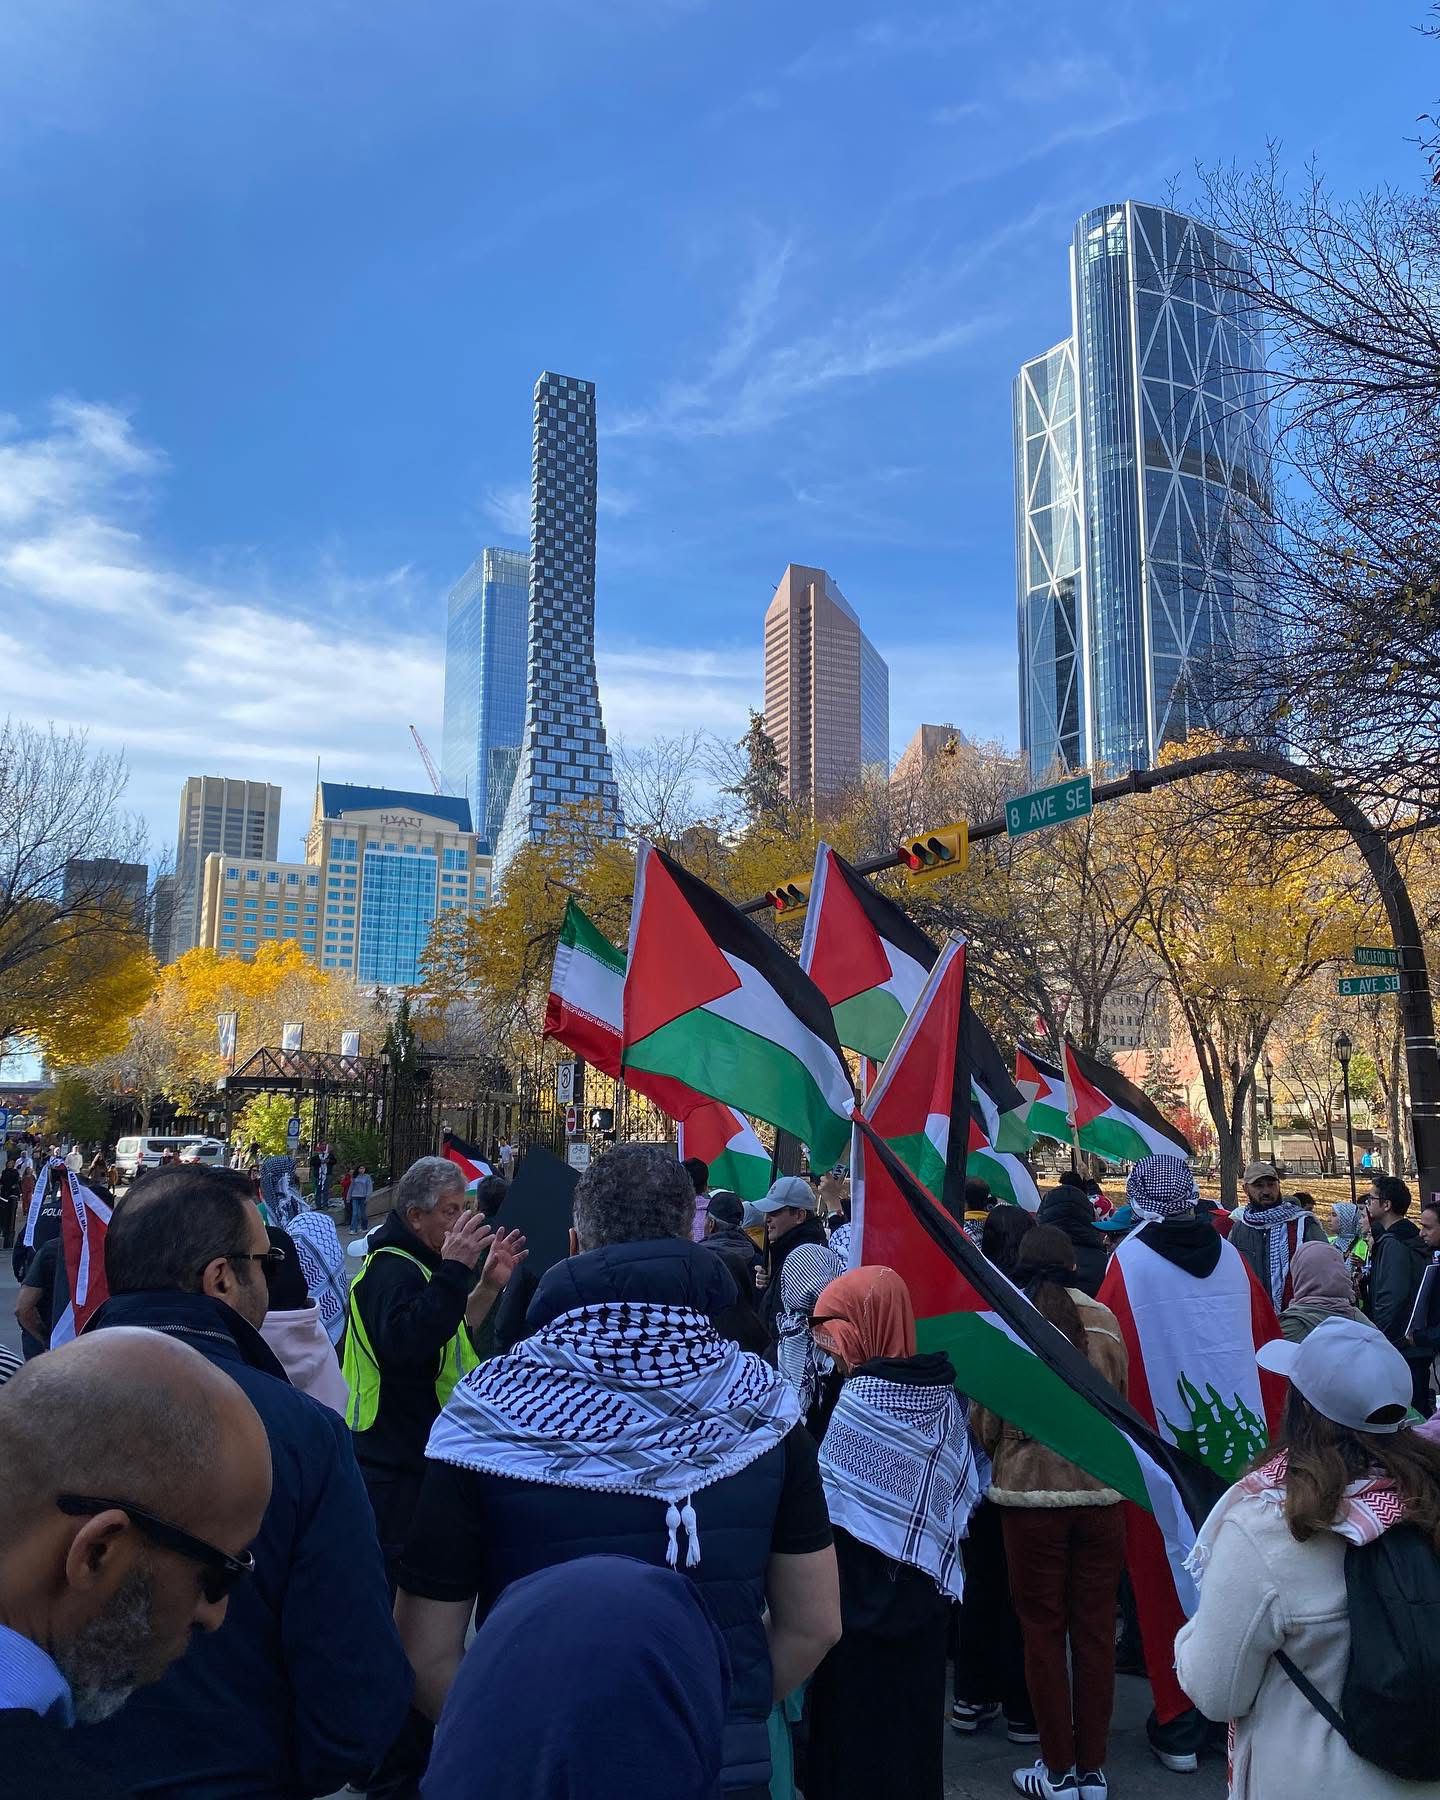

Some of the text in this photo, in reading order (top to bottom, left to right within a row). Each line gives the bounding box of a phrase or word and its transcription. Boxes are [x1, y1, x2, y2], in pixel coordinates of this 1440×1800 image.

[1010, 786, 1086, 828] 8 AVE SE
[380, 814, 424, 829] HYATT
[1357, 950, 1386, 963] MACLEOD
[1343, 976, 1398, 993] 8 AVE SE
[75, 1202, 85, 1219] STEVE
